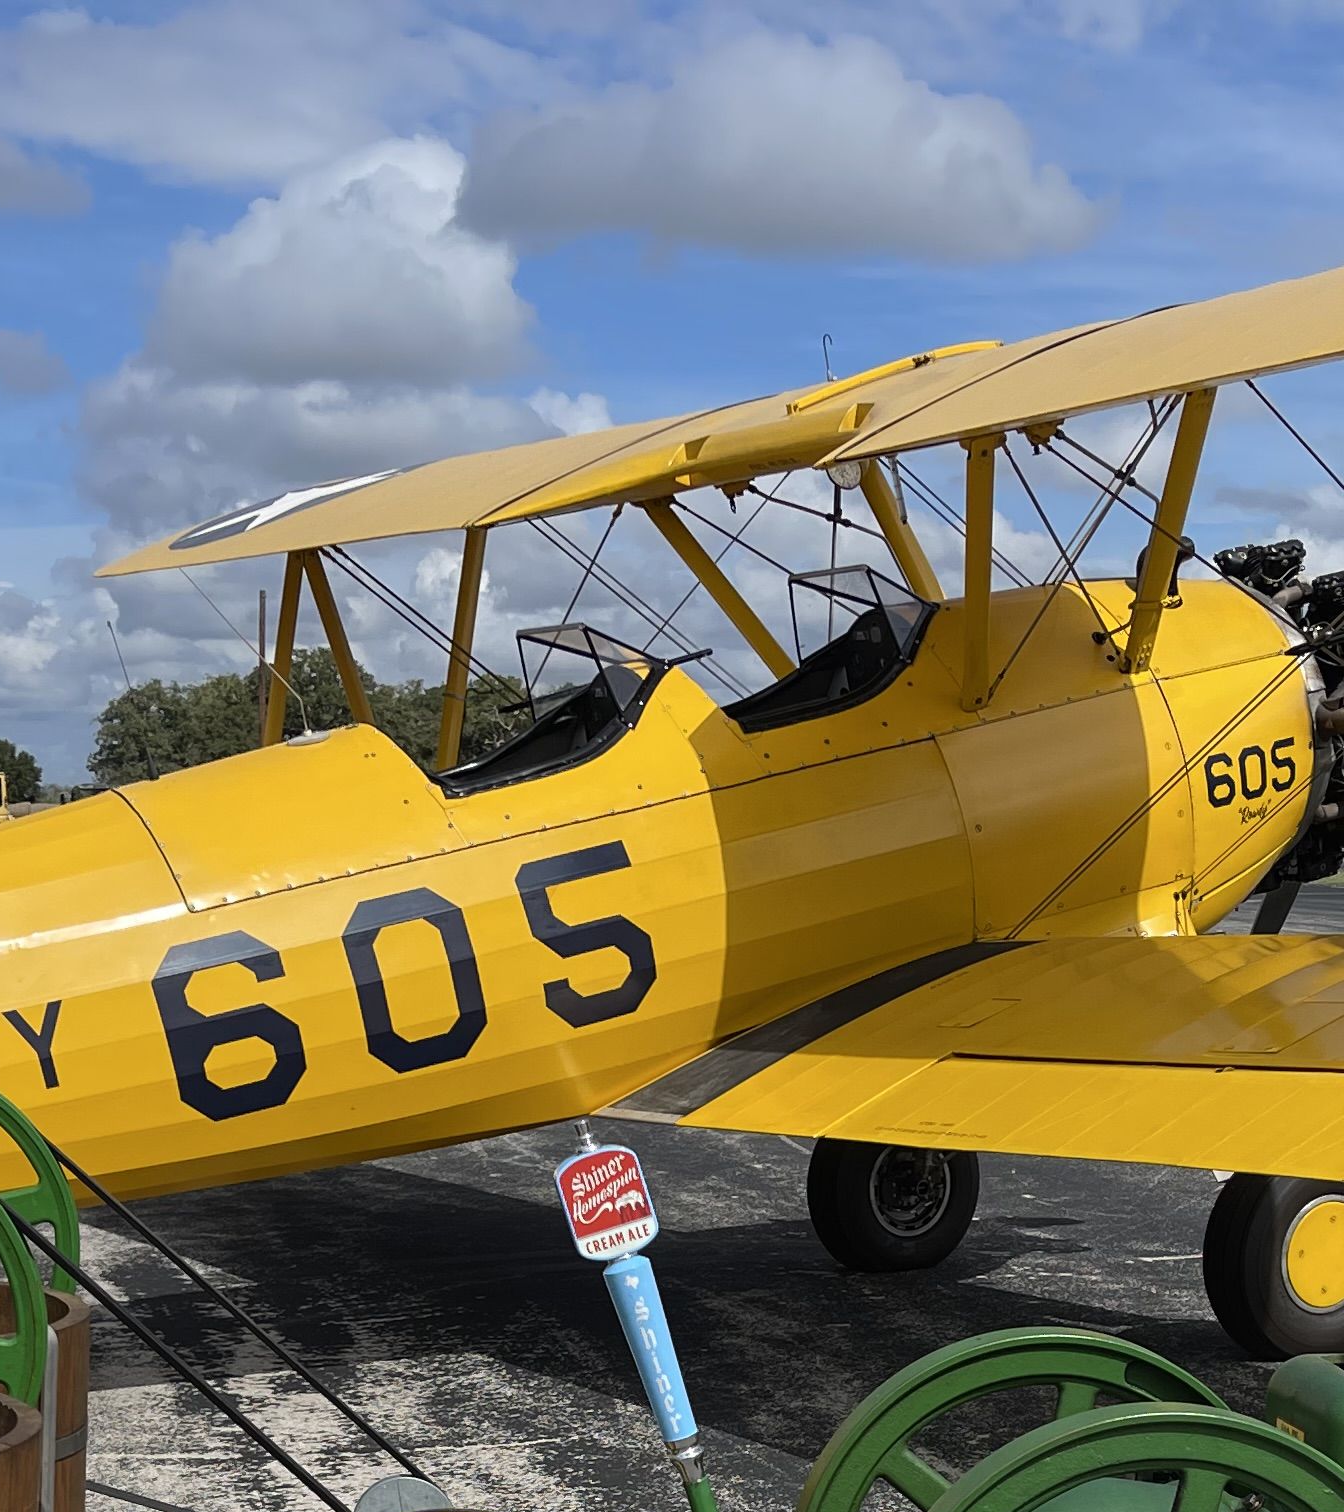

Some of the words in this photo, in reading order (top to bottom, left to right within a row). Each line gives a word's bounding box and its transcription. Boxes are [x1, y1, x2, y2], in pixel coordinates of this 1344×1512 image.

[1203, 736, 1296, 808] 605
[151, 840, 656, 1121] 605
[570, 1152, 627, 1199] Shiner
[585, 1228, 627, 1254] CREAM
[628, 1223, 652, 1244] ALE
[634, 1297, 683, 1434] Shiner
